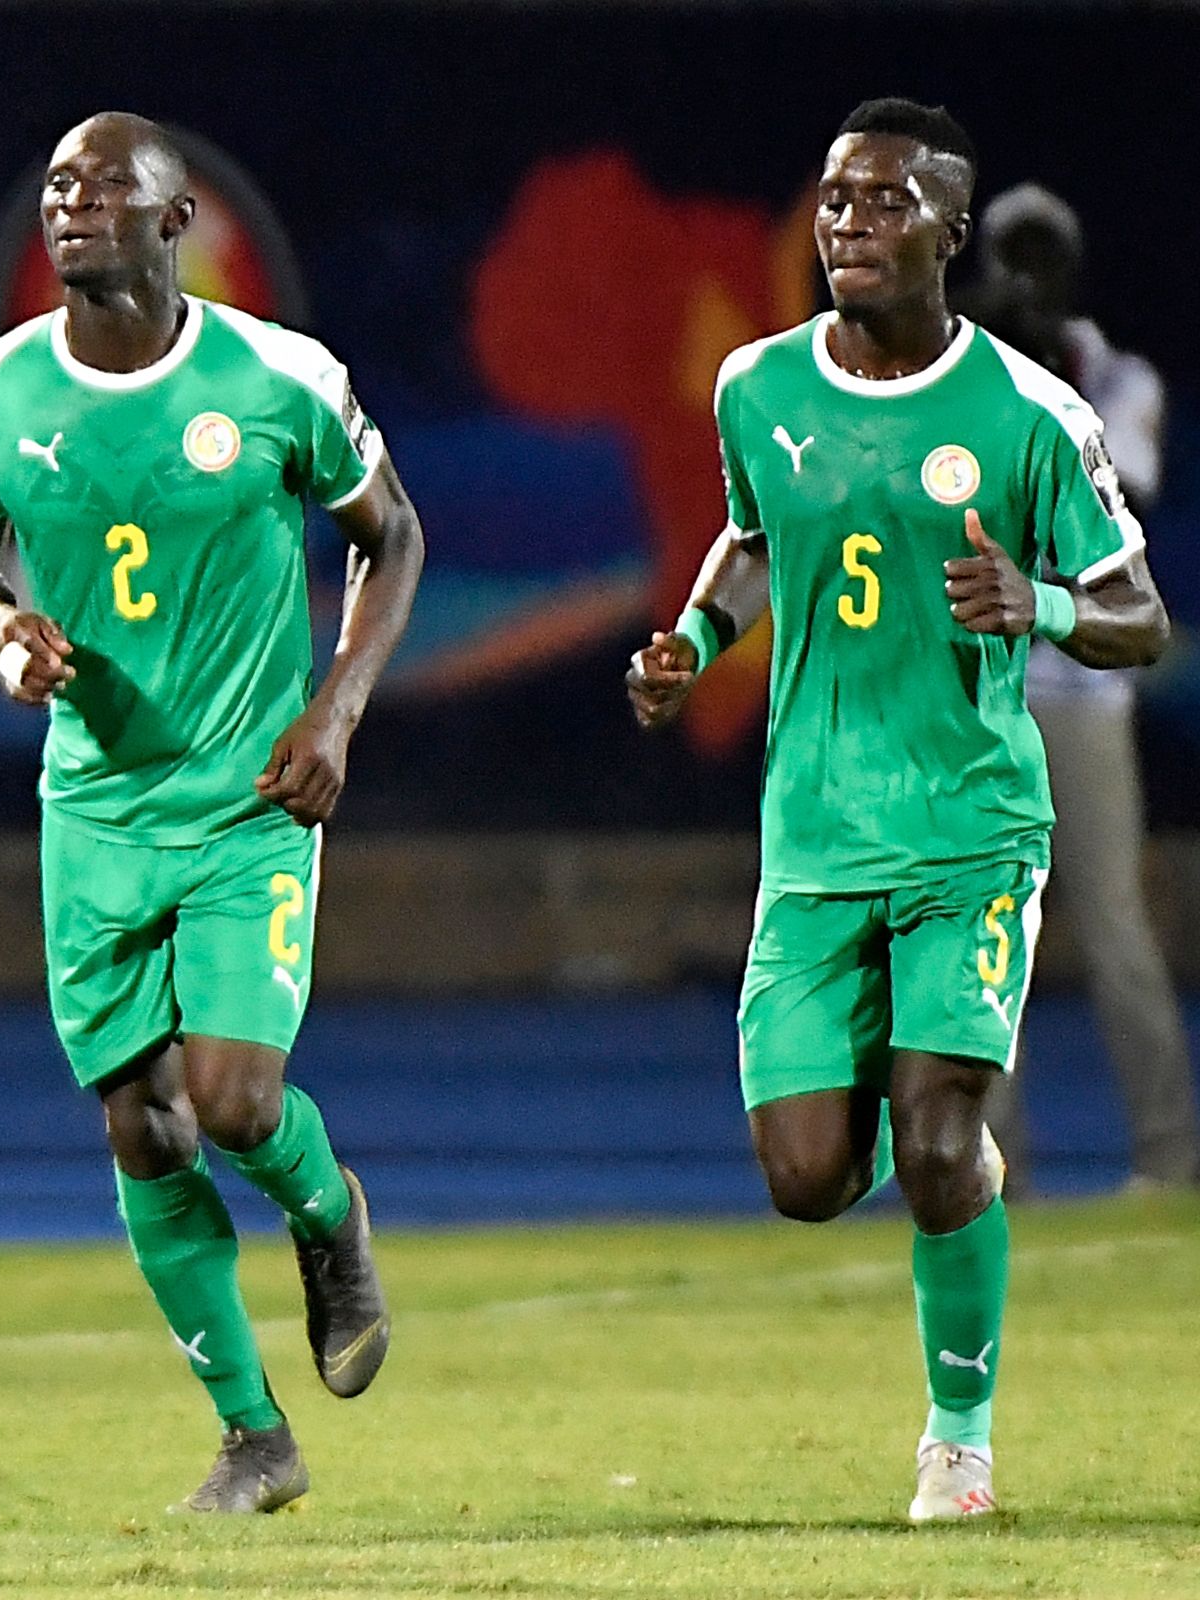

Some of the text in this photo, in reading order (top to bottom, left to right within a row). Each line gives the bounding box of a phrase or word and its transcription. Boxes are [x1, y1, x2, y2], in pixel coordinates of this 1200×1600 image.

[105, 523, 157, 620] 2
[838, 534, 881, 629] 5
[270, 872, 304, 964] 2
[977, 894, 1014, 984] 5
